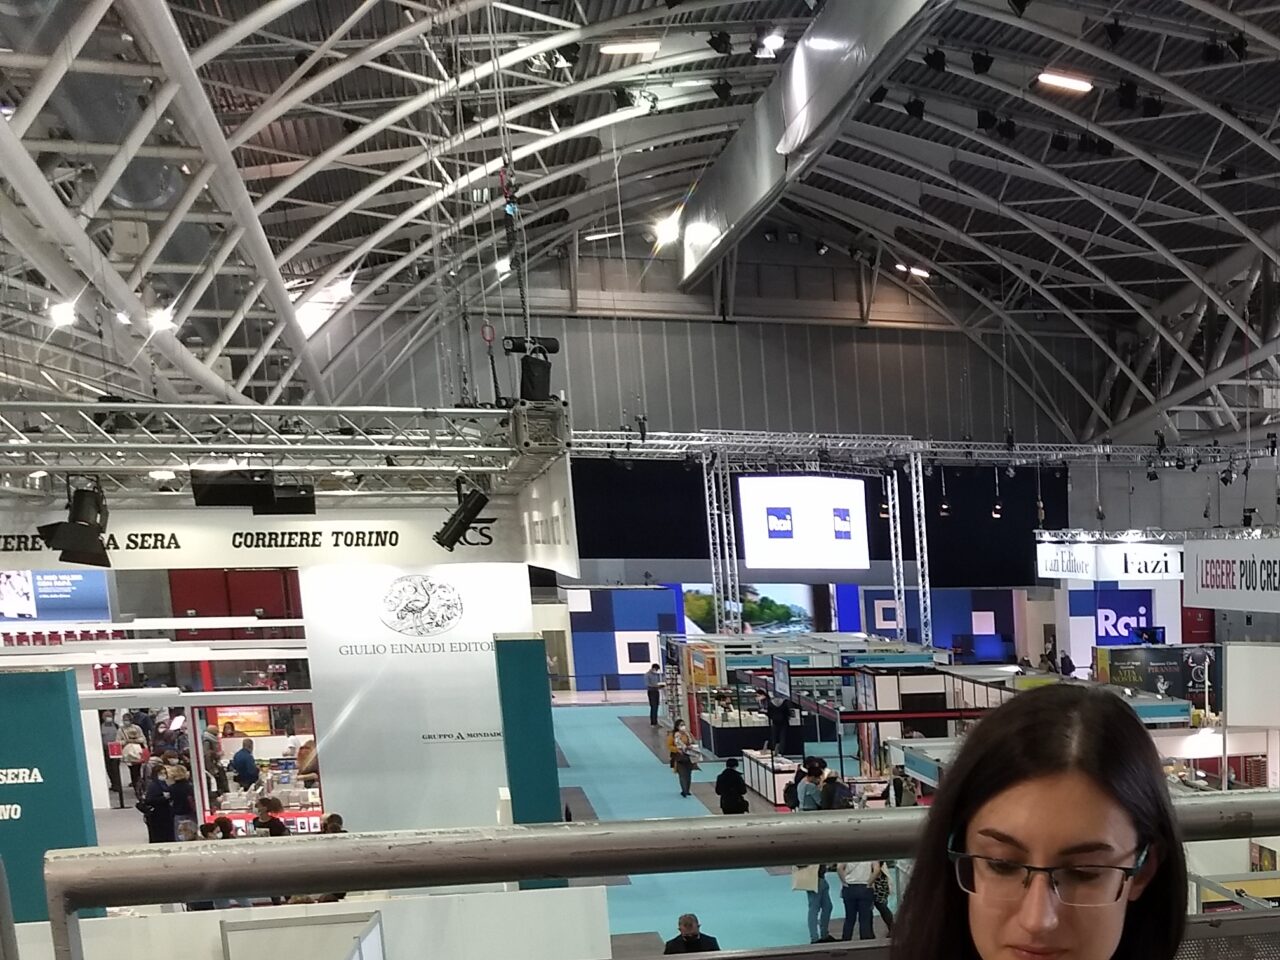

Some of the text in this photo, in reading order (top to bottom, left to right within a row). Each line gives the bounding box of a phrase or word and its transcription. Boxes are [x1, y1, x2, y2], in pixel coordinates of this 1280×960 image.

[769, 515, 792, 530] Rai
[126, 534, 181, 550] SERA
[232, 531, 399, 549] CORRIERE TORINO
[456, 527, 494, 546] CS
[1201, 559, 1236, 590] LEGGERE
[1240, 553, 1257, 591] PUÒ
[1097, 606, 1147, 637] Rai
[339, 644, 387, 657] GIULIO
[391, 642, 446, 655] EINAUDI
[422, 733, 454, 741] GRUPPO
[0, 767, 44, 784] SERA
